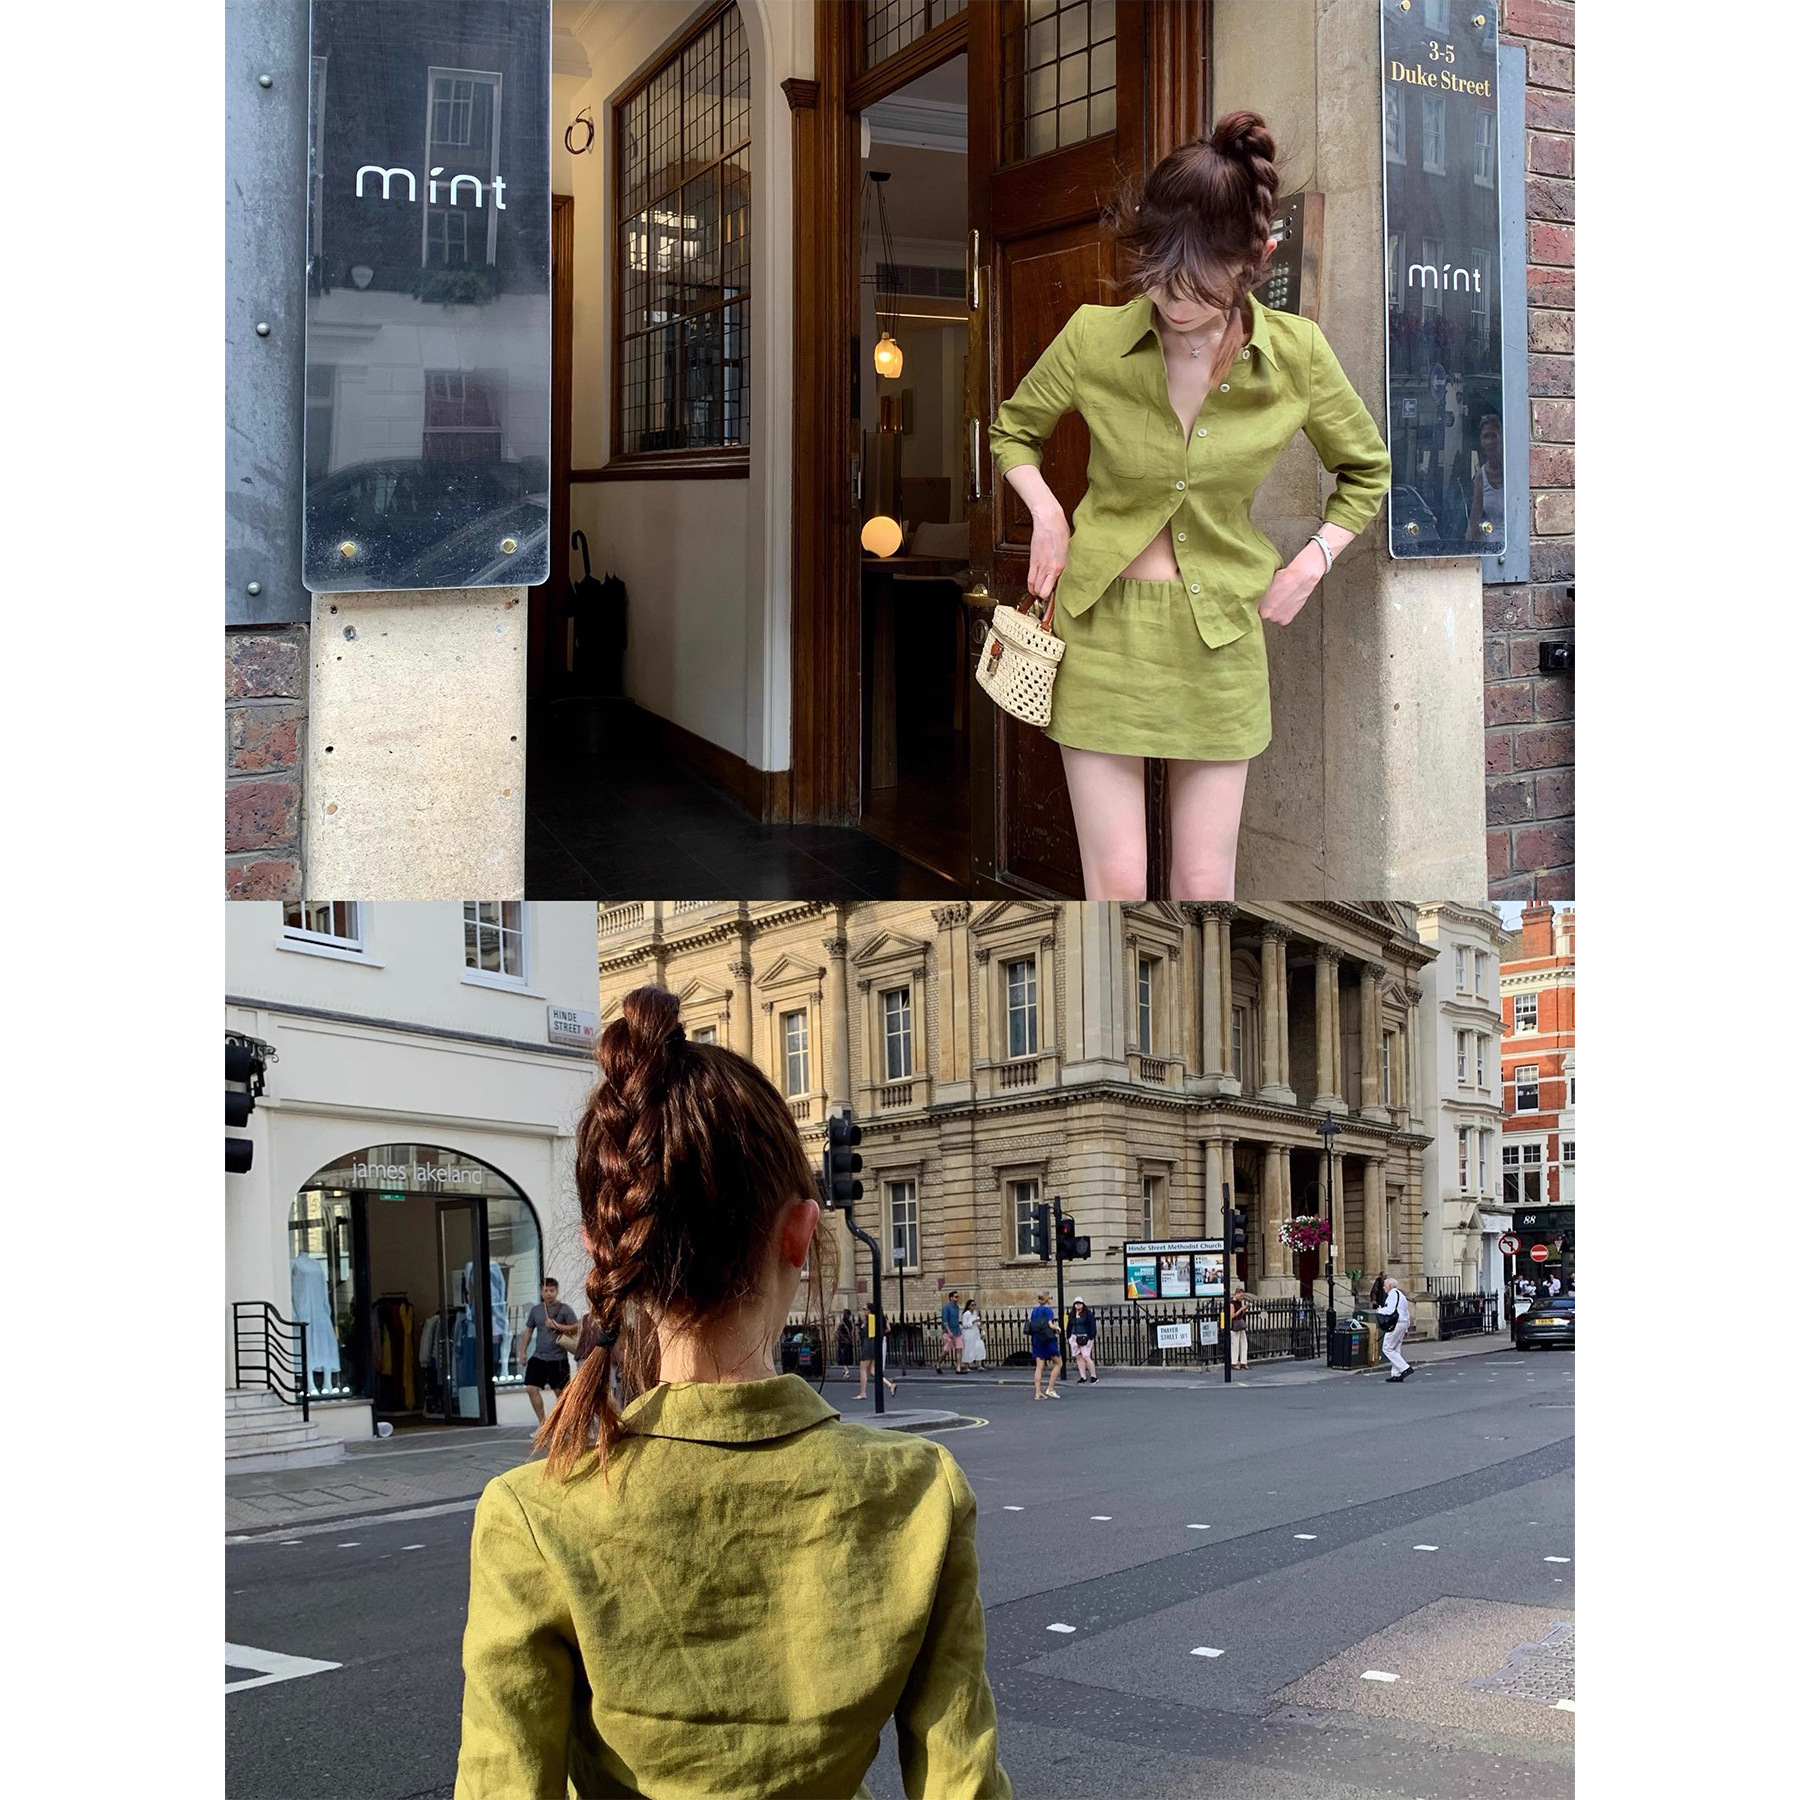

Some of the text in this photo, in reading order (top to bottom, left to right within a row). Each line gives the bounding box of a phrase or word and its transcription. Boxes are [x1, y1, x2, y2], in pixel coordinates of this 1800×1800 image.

[1429, 41, 1455, 63] 3-5
[1391, 61, 1491, 97] Duke Street
[356, 165, 506, 209] mint
[1408, 264, 1480, 292] mint
[553, 1009, 577, 1022] HINDE
[553, 1020, 581, 1034] STREET
[352, 1156, 482, 1184] james lakeland
[1523, 1215, 1536, 1225] 88
[1167, 1242, 1199, 1250] Methodist
[1200, 1241, 1222, 1249] Church
